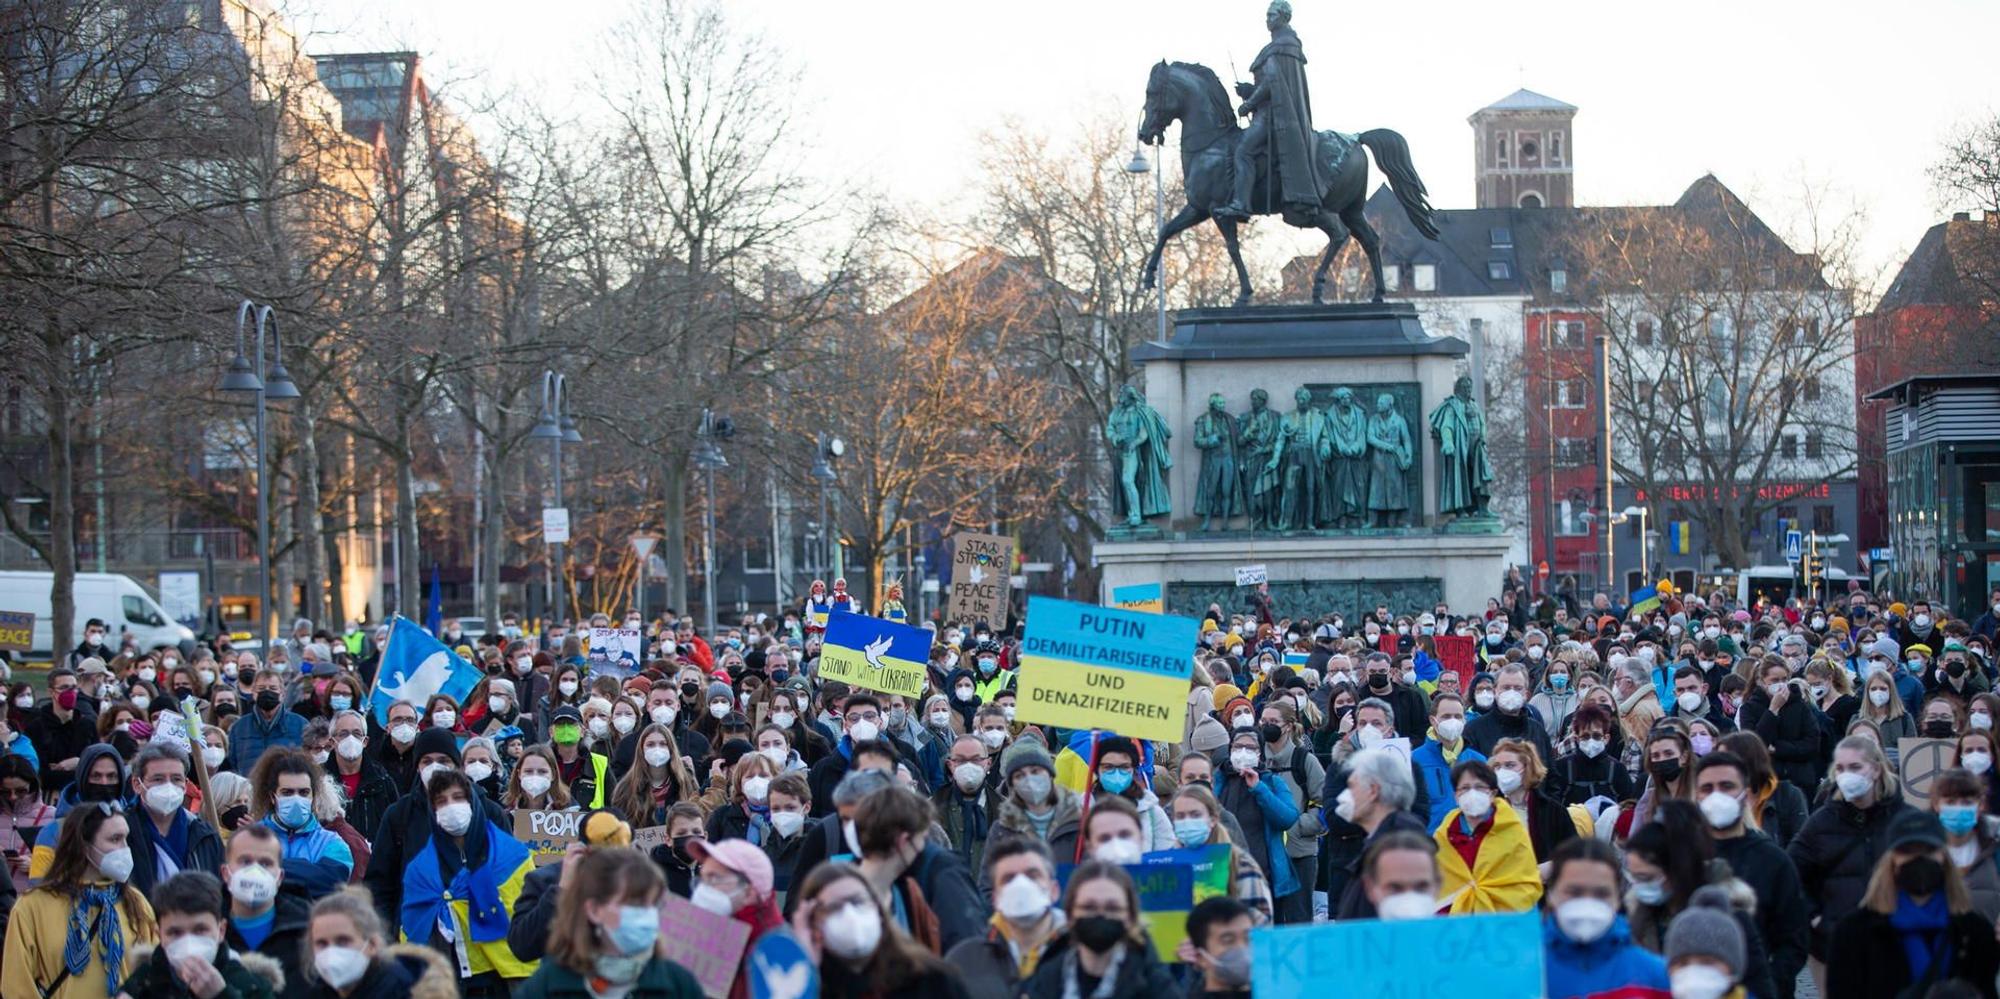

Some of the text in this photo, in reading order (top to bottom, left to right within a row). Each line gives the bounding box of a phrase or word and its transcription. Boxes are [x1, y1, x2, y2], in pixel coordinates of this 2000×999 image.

[955, 583, 995, 599] PEACE
[959, 598, 990, 613] 4 the
[1079, 614, 1146, 639] PUTIN
[1027, 637, 1187, 673] DEMILITARISIEREN
[822, 656, 852, 676] STAND
[880, 668, 921, 694] UKRAINE
[1086, 673, 1125, 690] UND
[1032, 688, 1170, 720] DENAZIFIZIEREN
[1266, 921, 1520, 979] KEIN GAS
